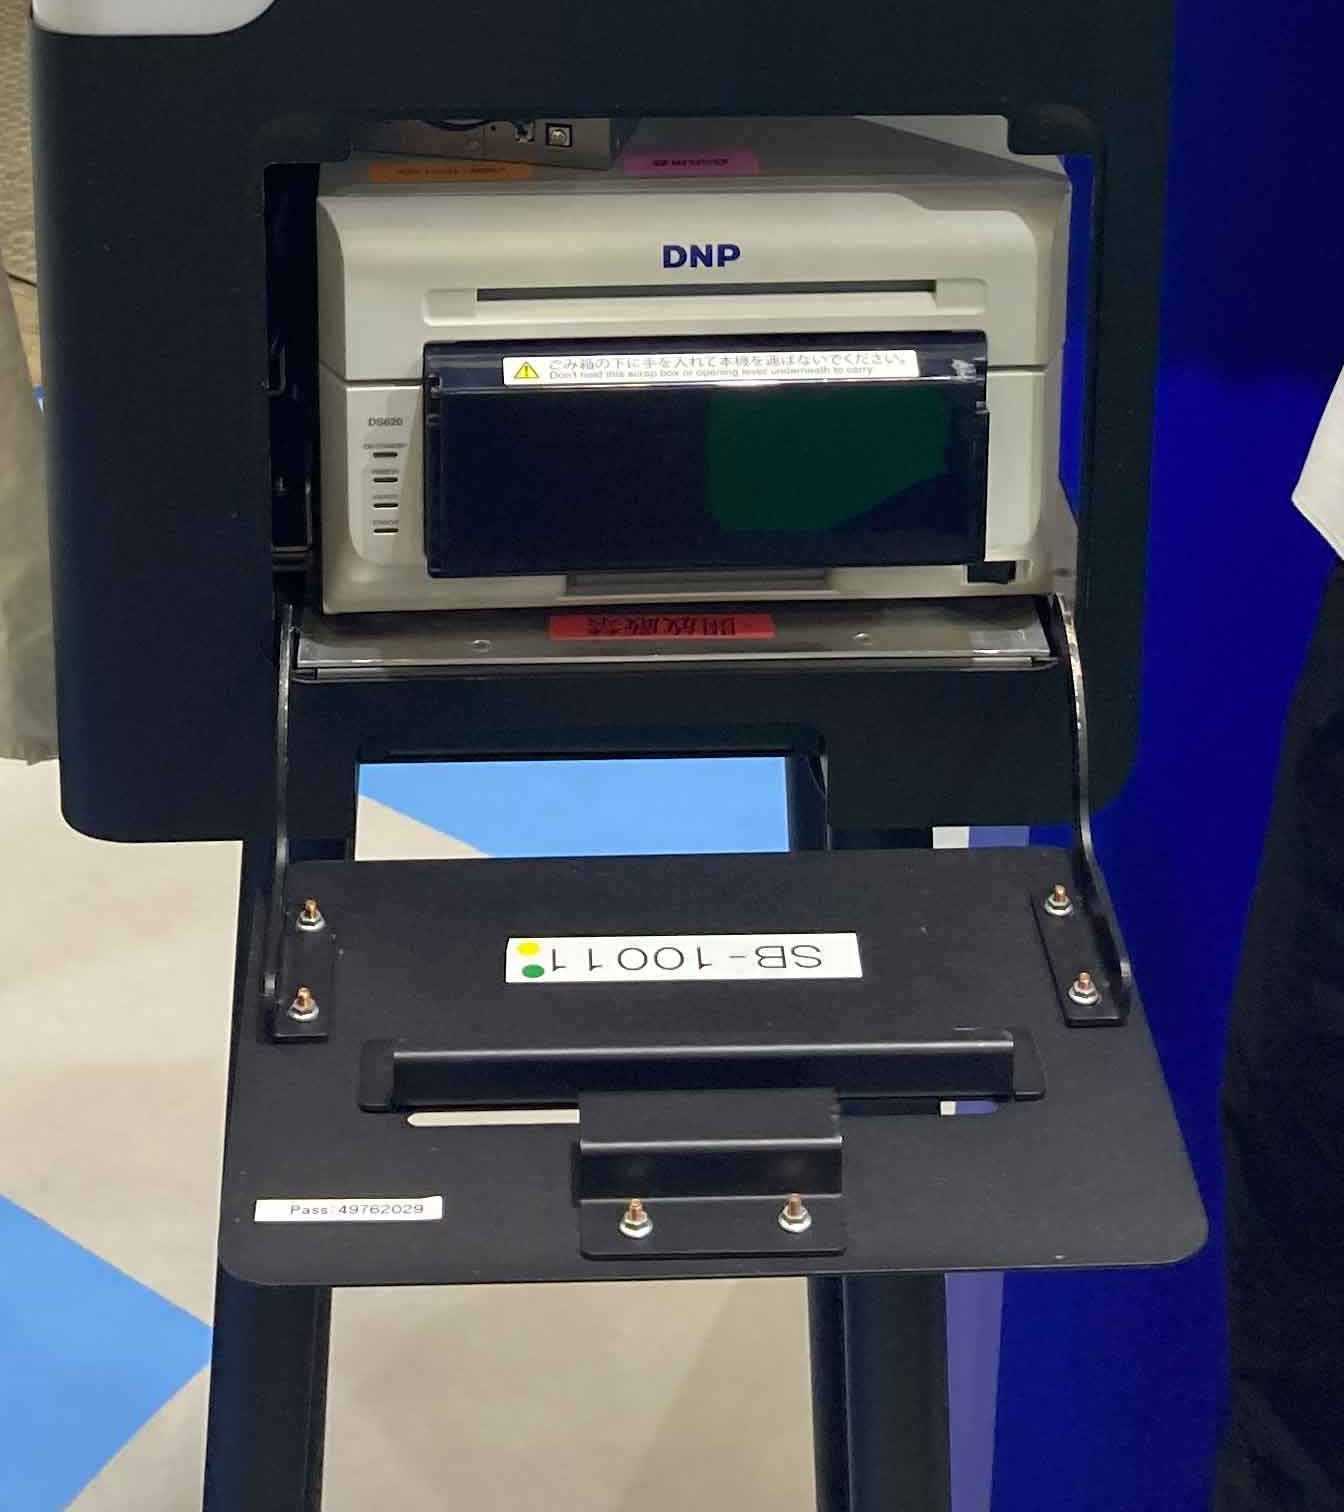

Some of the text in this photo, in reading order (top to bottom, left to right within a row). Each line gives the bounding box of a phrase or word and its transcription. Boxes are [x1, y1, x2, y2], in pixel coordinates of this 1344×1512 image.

[661, 244, 742, 269] DNP
[659, 367, 678, 377] box
[770, 365, 831, 376] underneath
[367, 417, 404, 427] DS620
[550, 945, 823, 972] SB-10011
[289, 1204, 425, 1216] Pass:49762029
